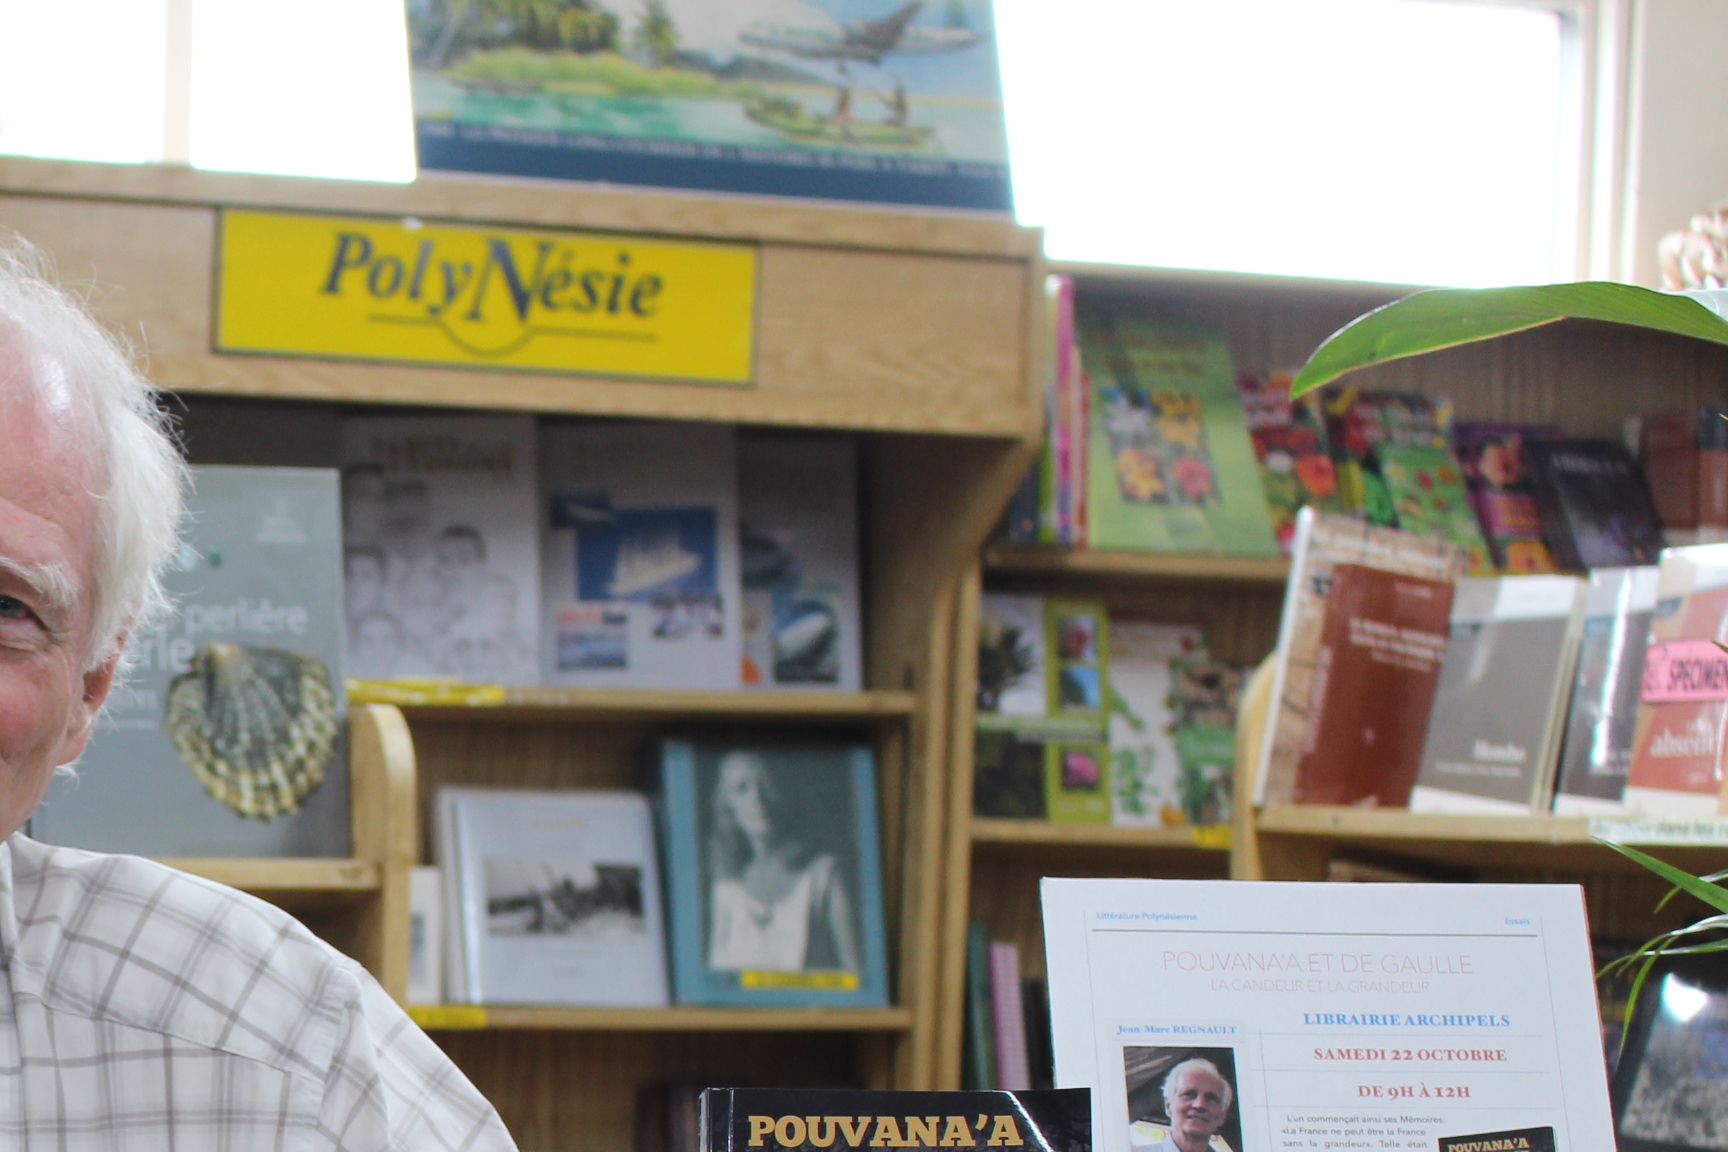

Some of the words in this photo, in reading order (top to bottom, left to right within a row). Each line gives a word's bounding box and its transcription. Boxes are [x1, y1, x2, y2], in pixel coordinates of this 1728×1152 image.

[321, 231, 665, 322] PolyNésie
[1096, 911, 1140, 921] Littérature
[1142, 912, 1198, 923] Polynésienne
[1504, 917, 1530, 926] Essais
[1162, 951, 1300, 973] POUVANA'A
[1308, 953, 1334, 974] ET
[1342, 953, 1374, 974] DE
[1380, 954, 1474, 975] GAULLE
[1210, 979, 1229, 992] LA
[1232, 979, 1303, 993] CANDEUR
[1307, 979, 1323, 993] ET
[1327, 980, 1345, 993] LA
[1347, 979, 1431, 994] GRANDEUR
[1303, 1013, 1401, 1027] LIBRAIRIE
[1403, 1014, 1511, 1028] ARCHIPELS
[1117, 1024, 1170, 1035] Jean-Marc
[1173, 1025, 1237, 1035] REGNAULT
[1313, 1047, 1386, 1061] SAMEDI
[1390, 1049, 1413, 1062] 22
[1418, 1048, 1508, 1062] OCTOBRE
[1358, 1084, 1384, 1098] DE
[1387, 1084, 1414, 1101] 9H
[1419, 1080, 1431, 1098] À
[1435, 1085, 1471, 1099] 12H
[1287, 1114, 1304, 1123] L'un
[1307, 1114, 1359, 1125] commençait
[1362, 1115, 1381, 1124] ainsi
[1383, 1116, 1398, 1124] ses
[1399, 1115, 1445, 1124] Mémoires:
[748, 1114, 1024, 1147] POUVANA'A
[1282, 1126, 1296, 1136] «La
[1299, 1126, 1328, 1136] France
[1331, 1128, 1341, 1136] ne
[1344, 1128, 1365, 1138] peut
[1367, 1127, 1384, 1137] être
[1387, 1127, 1395, 1137] la
[1397, 1127, 1426, 1137] France
[1283, 1140, 1303, 1148] sans
[1309, 1138, 1317, 1148] la
[1324, 1139, 1373, 1150] grandeur».
[1379, 1139, 1401, 1149] Telle
[1407, 1140, 1428, 1149] était
